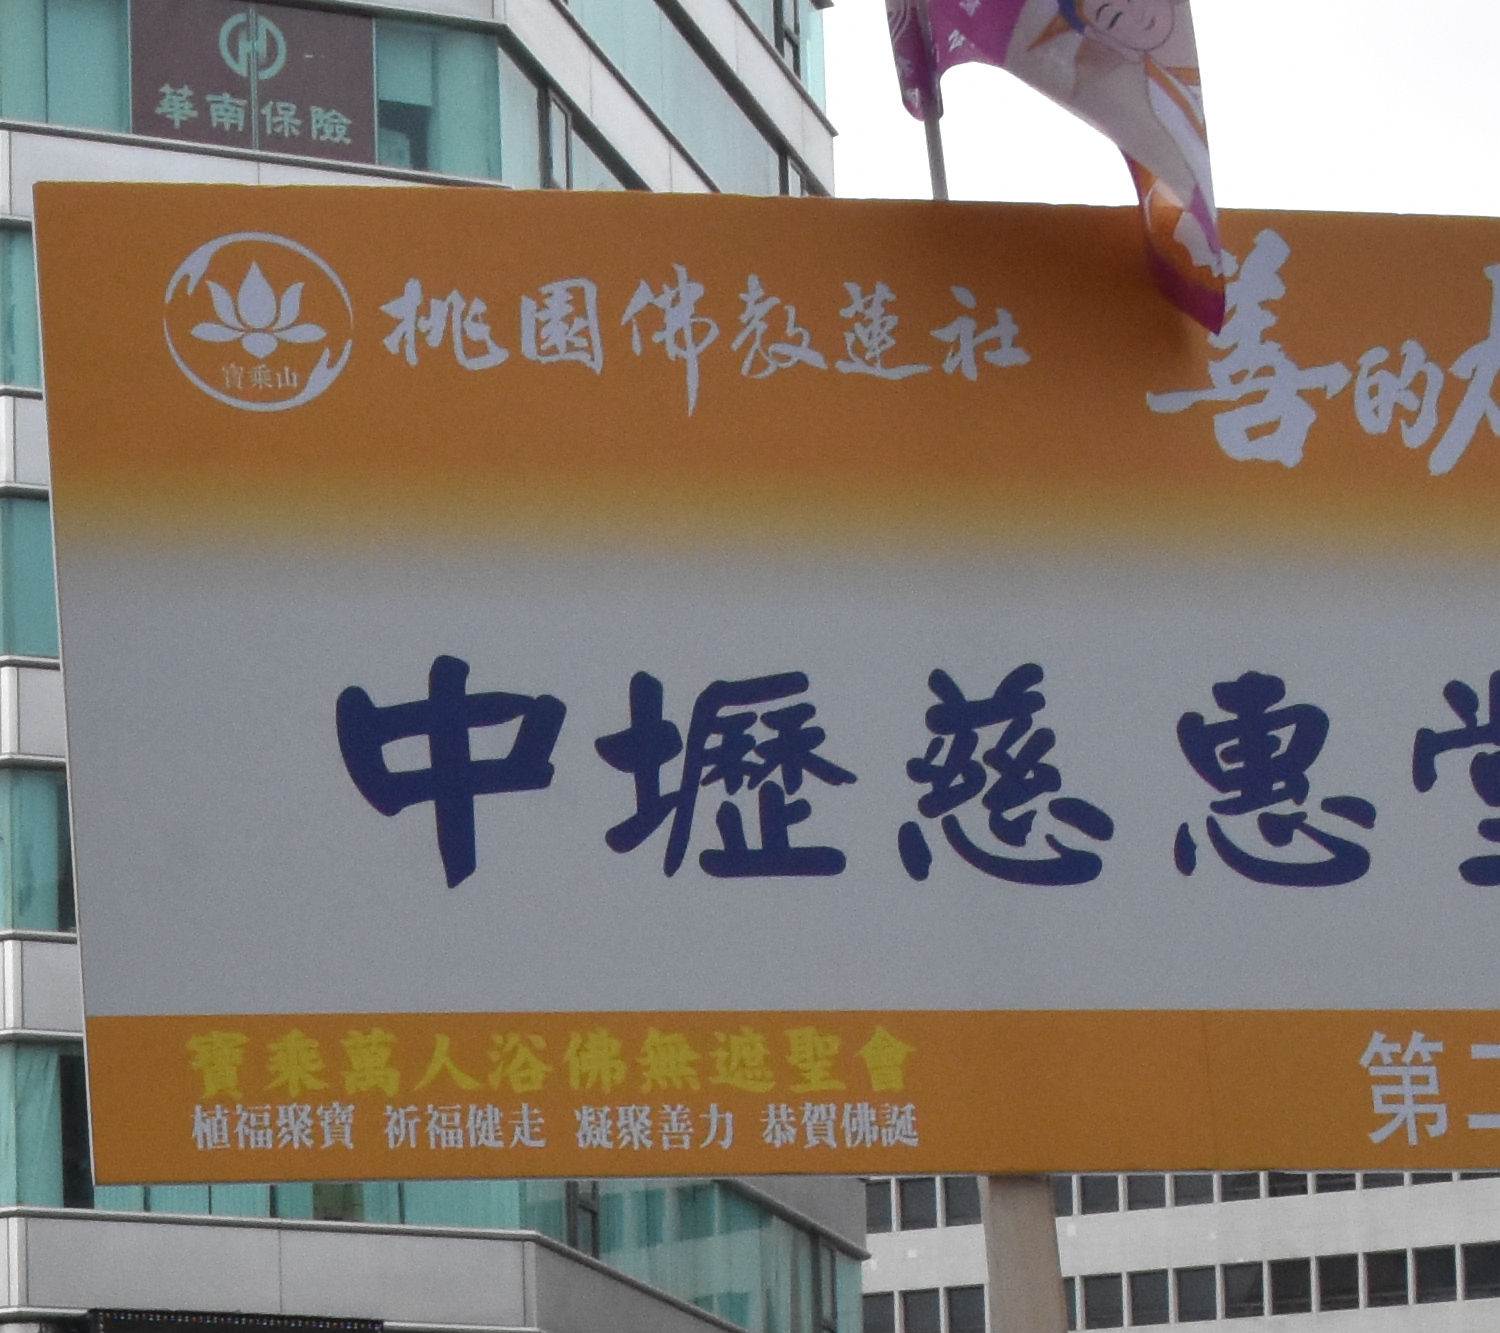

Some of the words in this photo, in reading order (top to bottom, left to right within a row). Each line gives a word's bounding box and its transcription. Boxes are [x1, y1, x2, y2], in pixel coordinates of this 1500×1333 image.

[152, 81, 356, 147] 華南保險
[380, 264, 1033, 417] 桃園佛教蓮社
[221, 361, 300, 391] 寶乘山
[186, 1024, 919, 1102] 寶乘萬人浴佛無遮聖會
[190, 1103, 355, 1152] 植福聚寶
[383, 1102, 548, 1151] 祈福健走
[573, 1101, 736, 1151] 凝聚善力
[758, 1100, 920, 1151] 恭賀佛誕
